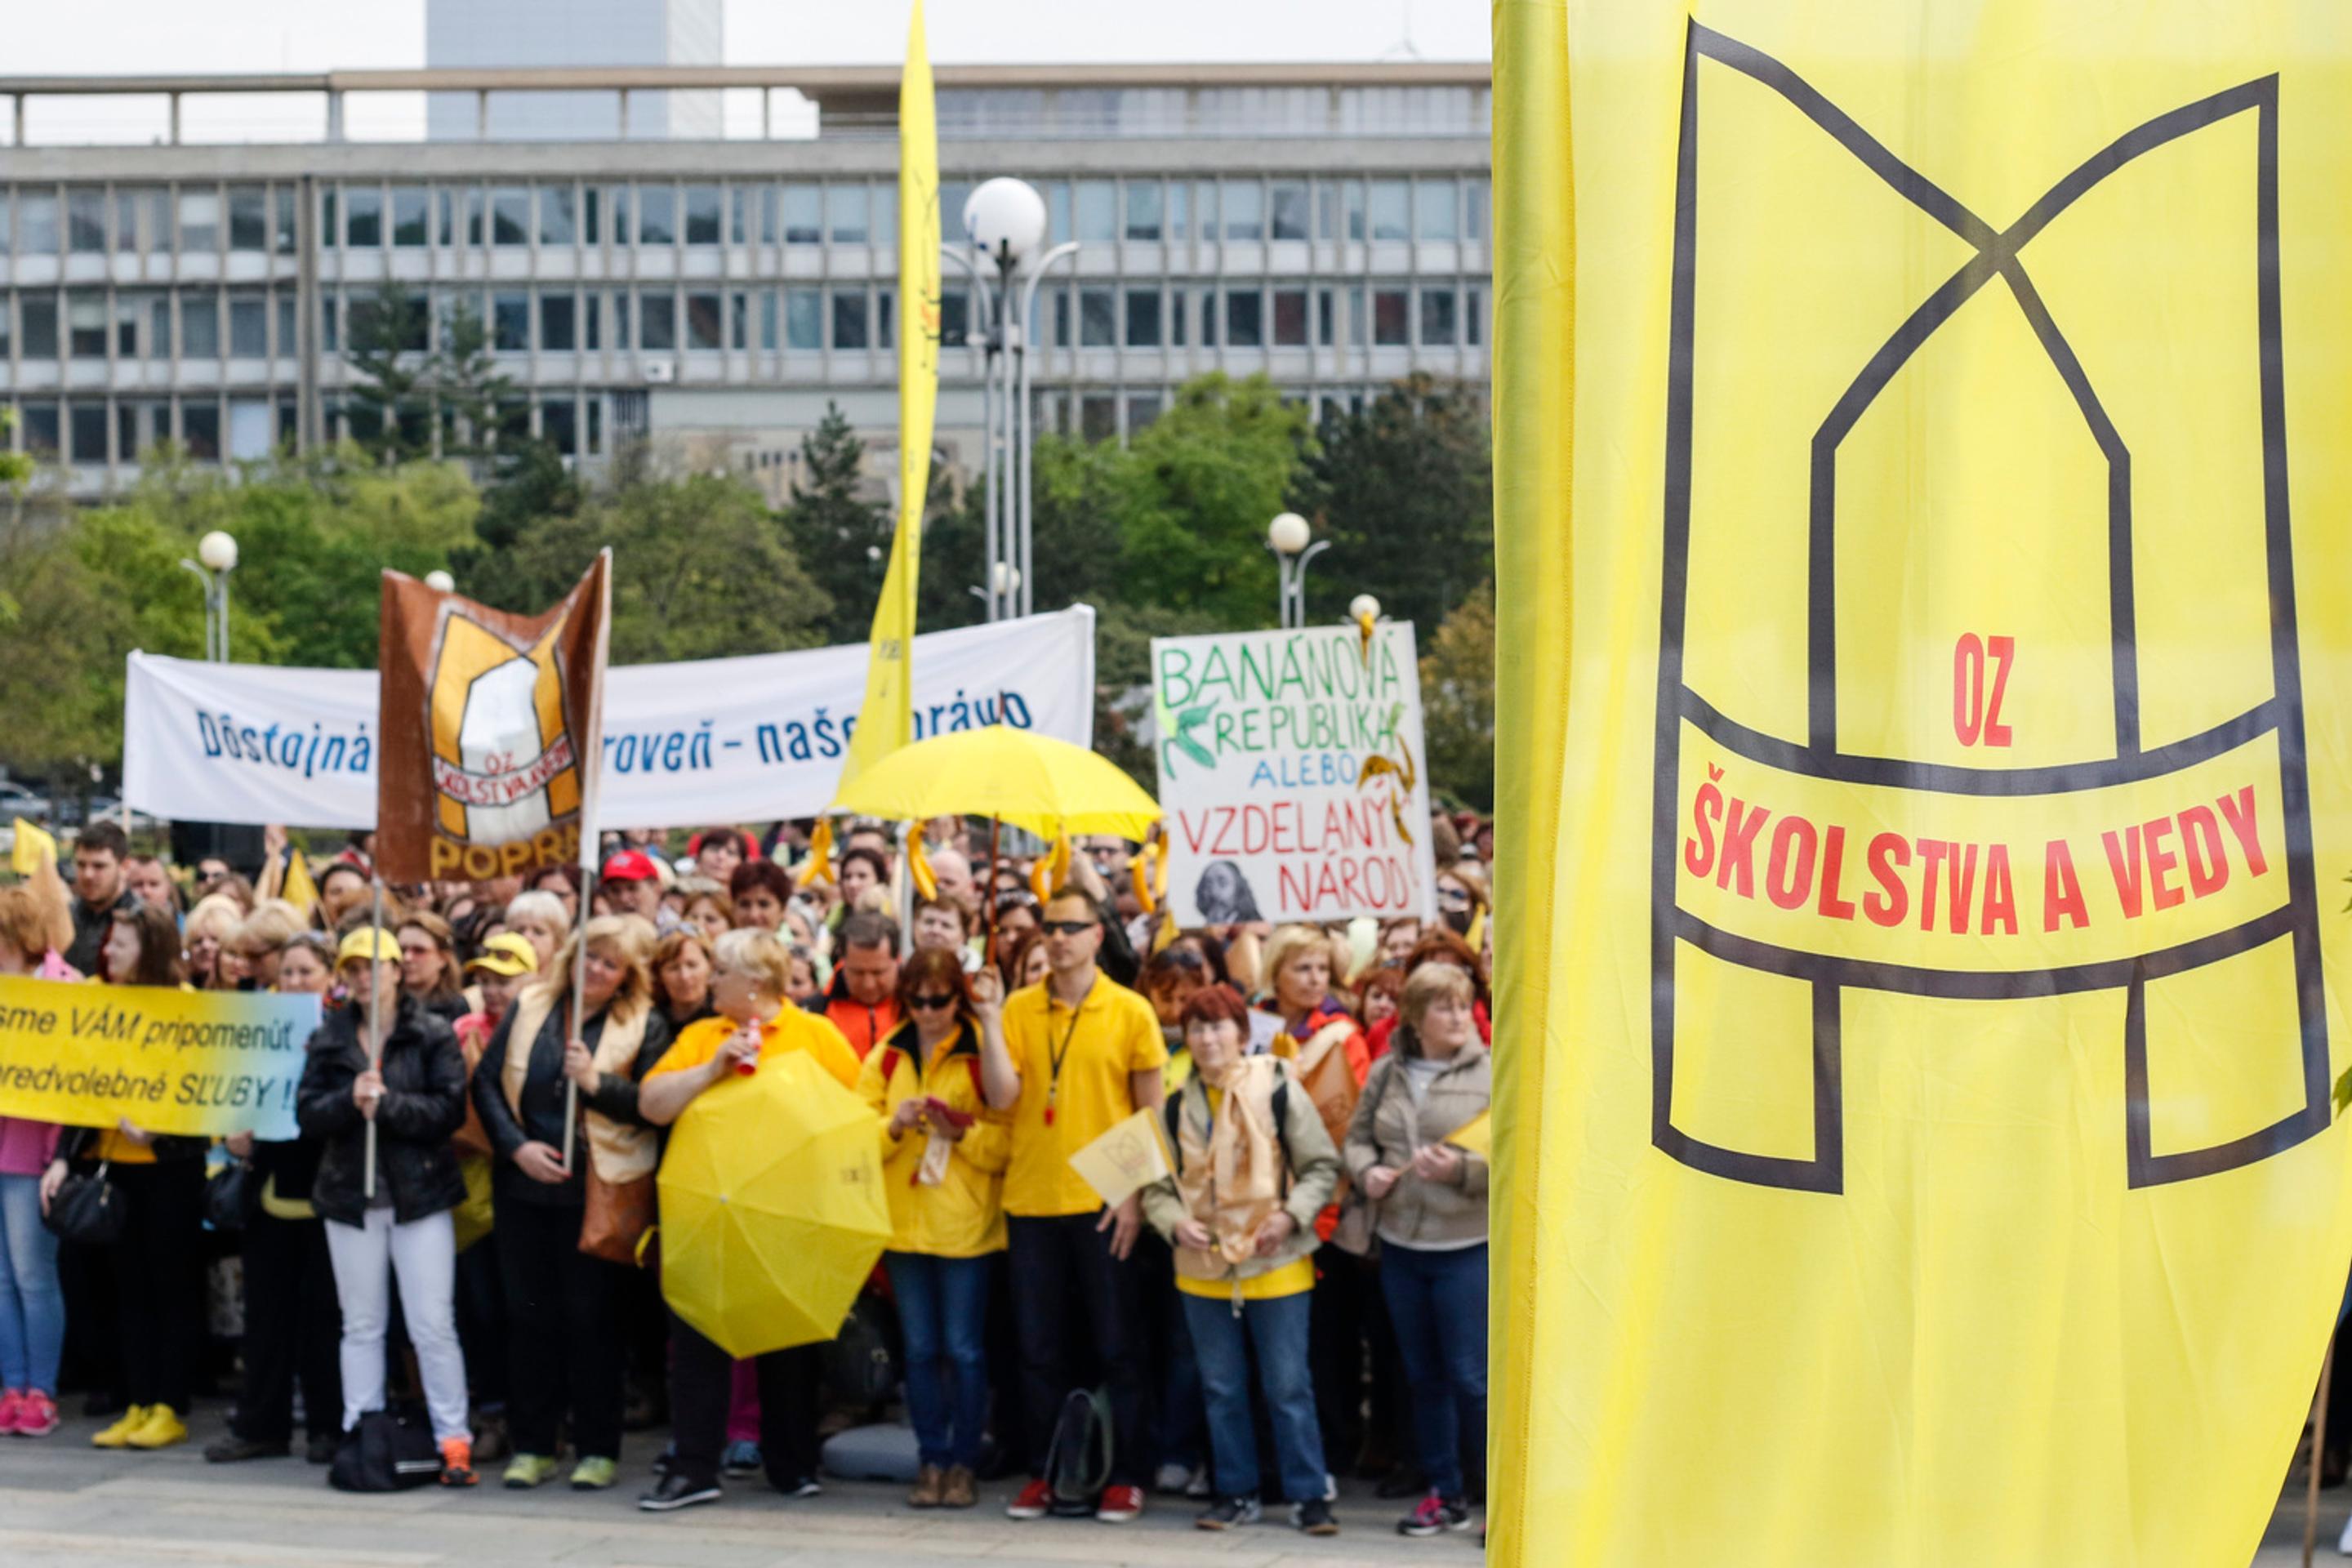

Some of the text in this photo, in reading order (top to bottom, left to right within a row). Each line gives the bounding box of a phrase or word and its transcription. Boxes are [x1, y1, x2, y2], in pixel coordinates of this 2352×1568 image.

[1160, 630, 1402, 708] BANÁNOVÁ
[1955, 632, 2015, 747] OZ
[196, 710, 371, 777] Dôstojná
[603, 719, 714, 773] roveň
[1216, 702, 1396, 756] REPUBLIKA
[486, 750, 517, 775] OZ
[1250, 753, 1358, 789] ALEBO
[1686, 762, 2269, 935] ŠKOLSTVA A VEDY
[1279, 851, 1410, 912] NÁROD
[69, 1004, 141, 1041] VÁM
[0, 1062, 168, 1103] redvolebné
